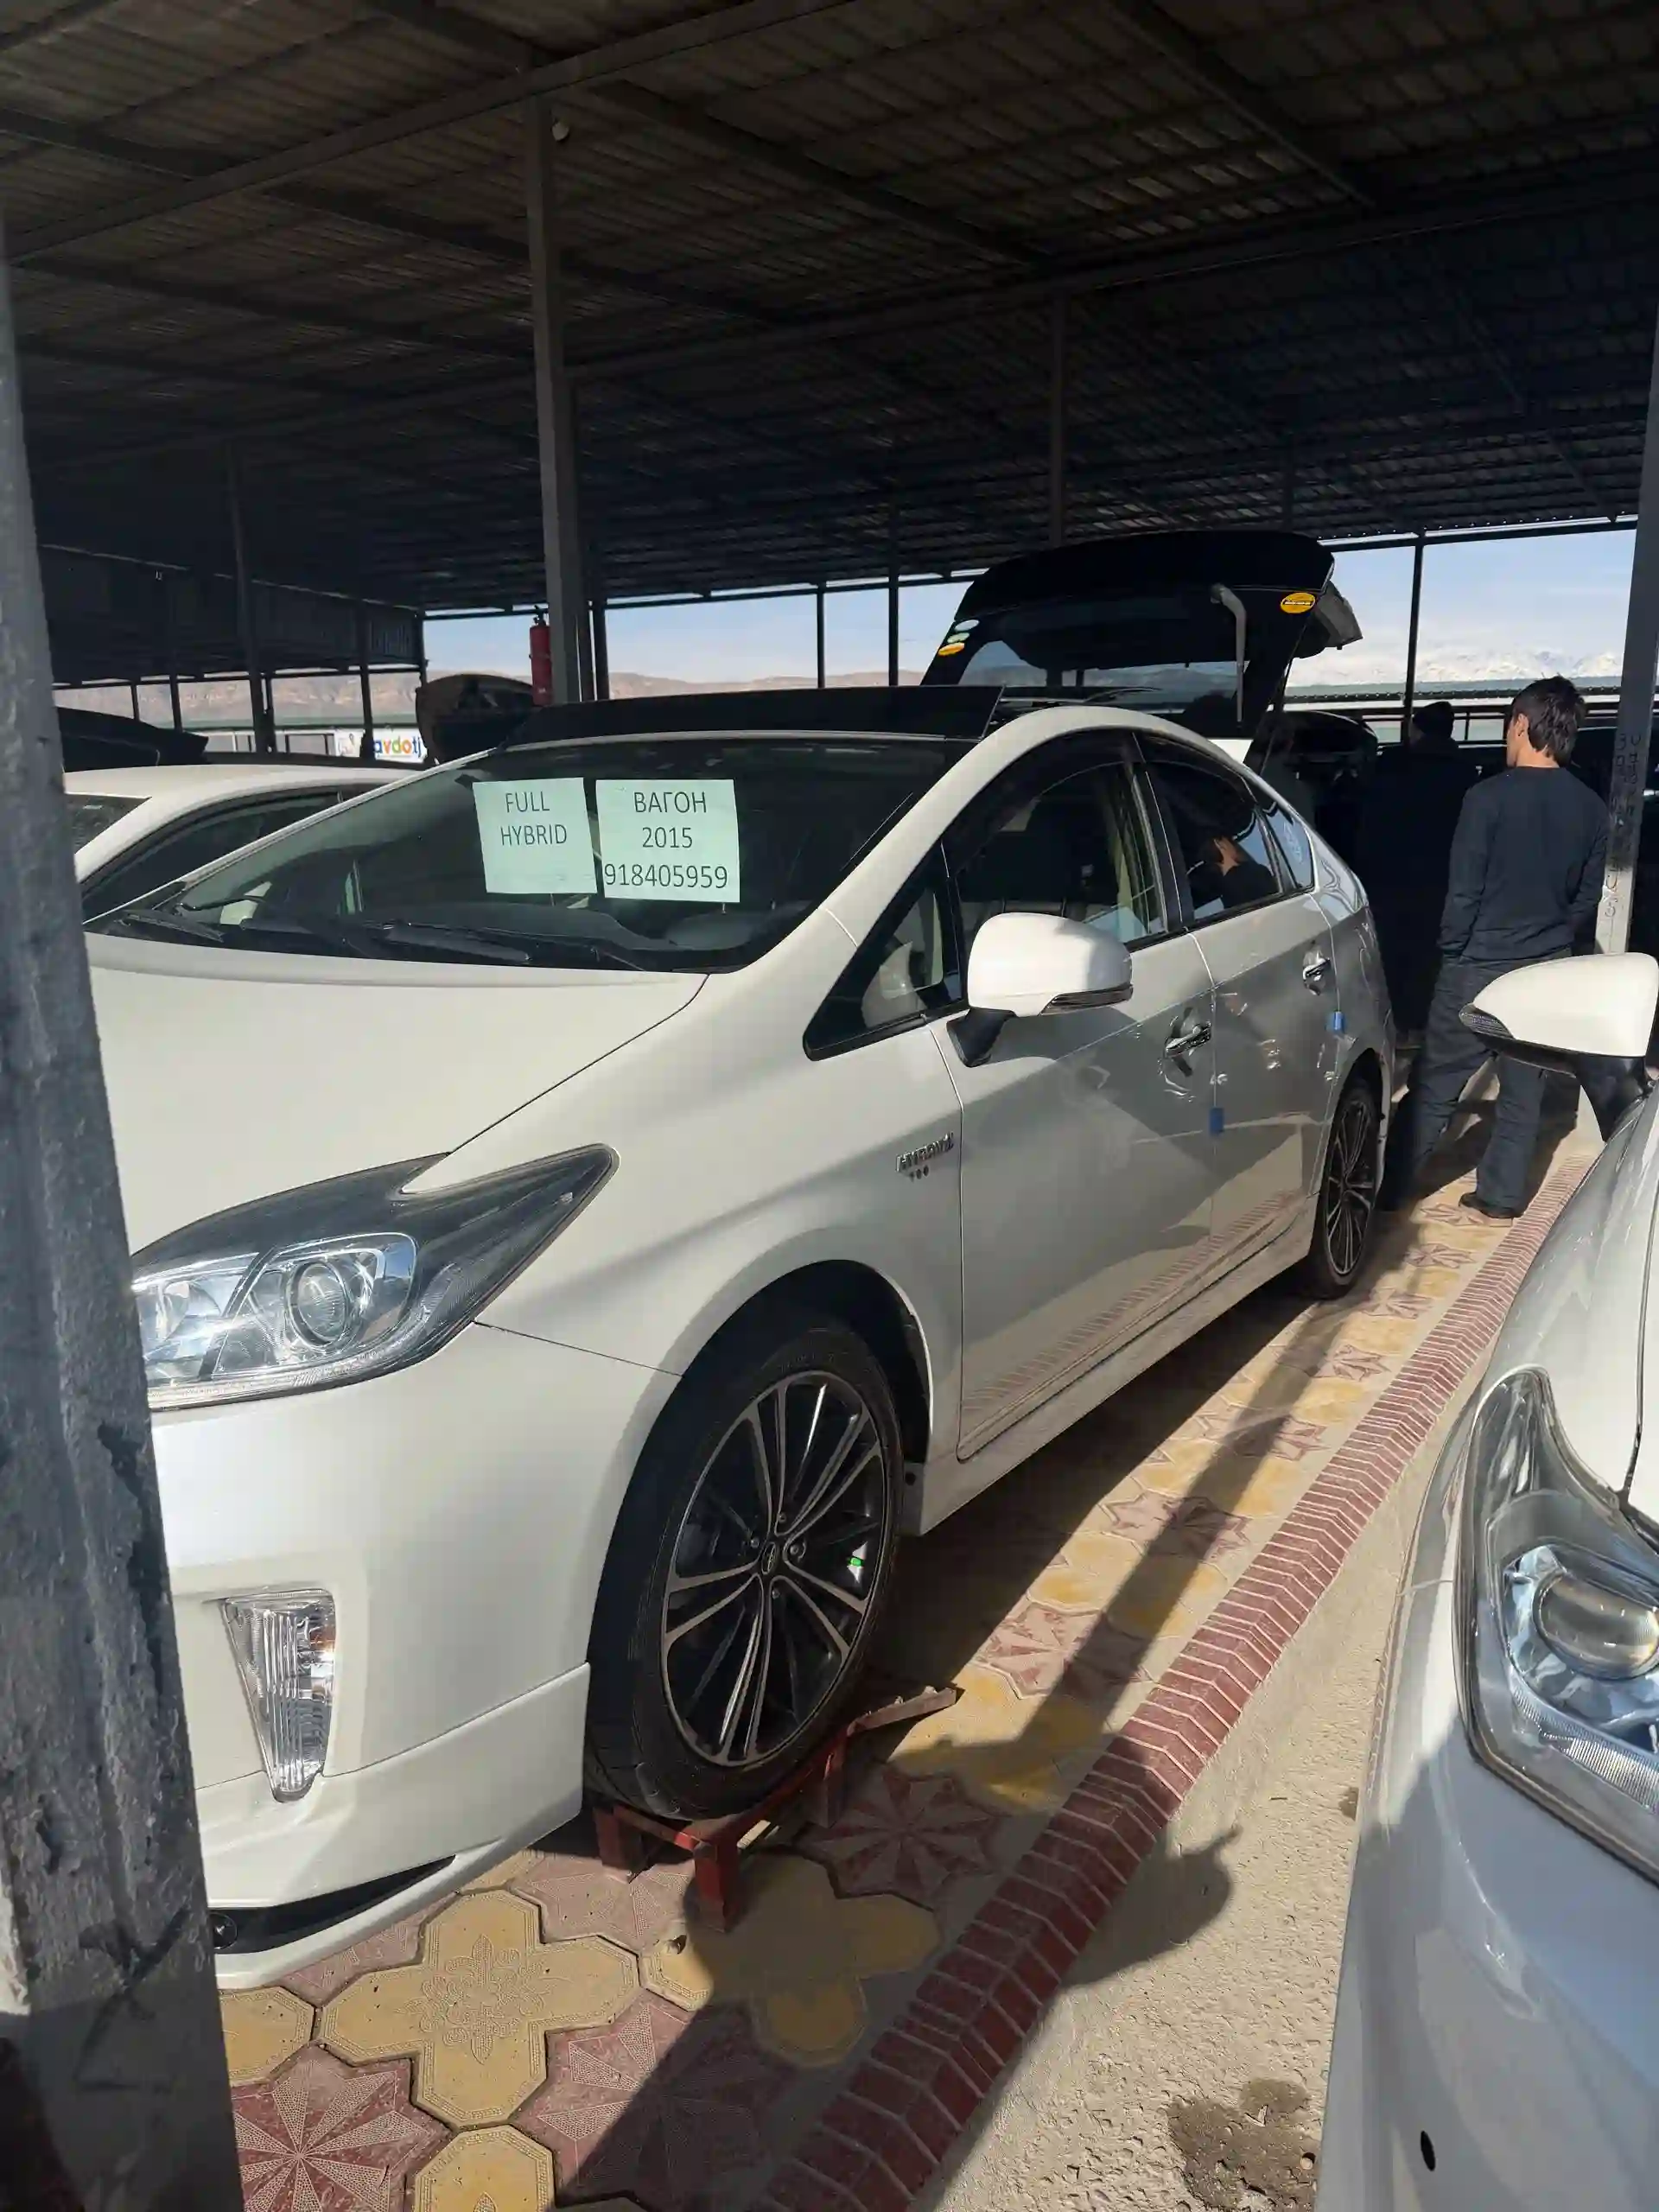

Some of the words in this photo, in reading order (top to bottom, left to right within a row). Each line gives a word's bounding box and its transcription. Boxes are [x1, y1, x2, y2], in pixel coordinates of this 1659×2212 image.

[505, 791, 550, 813] FULL
[634, 791, 707, 813] ВАГОН
[500, 823, 568, 846] HYBRID
[642, 827, 693, 849] 2015
[604, 863, 728, 889] 918405959
